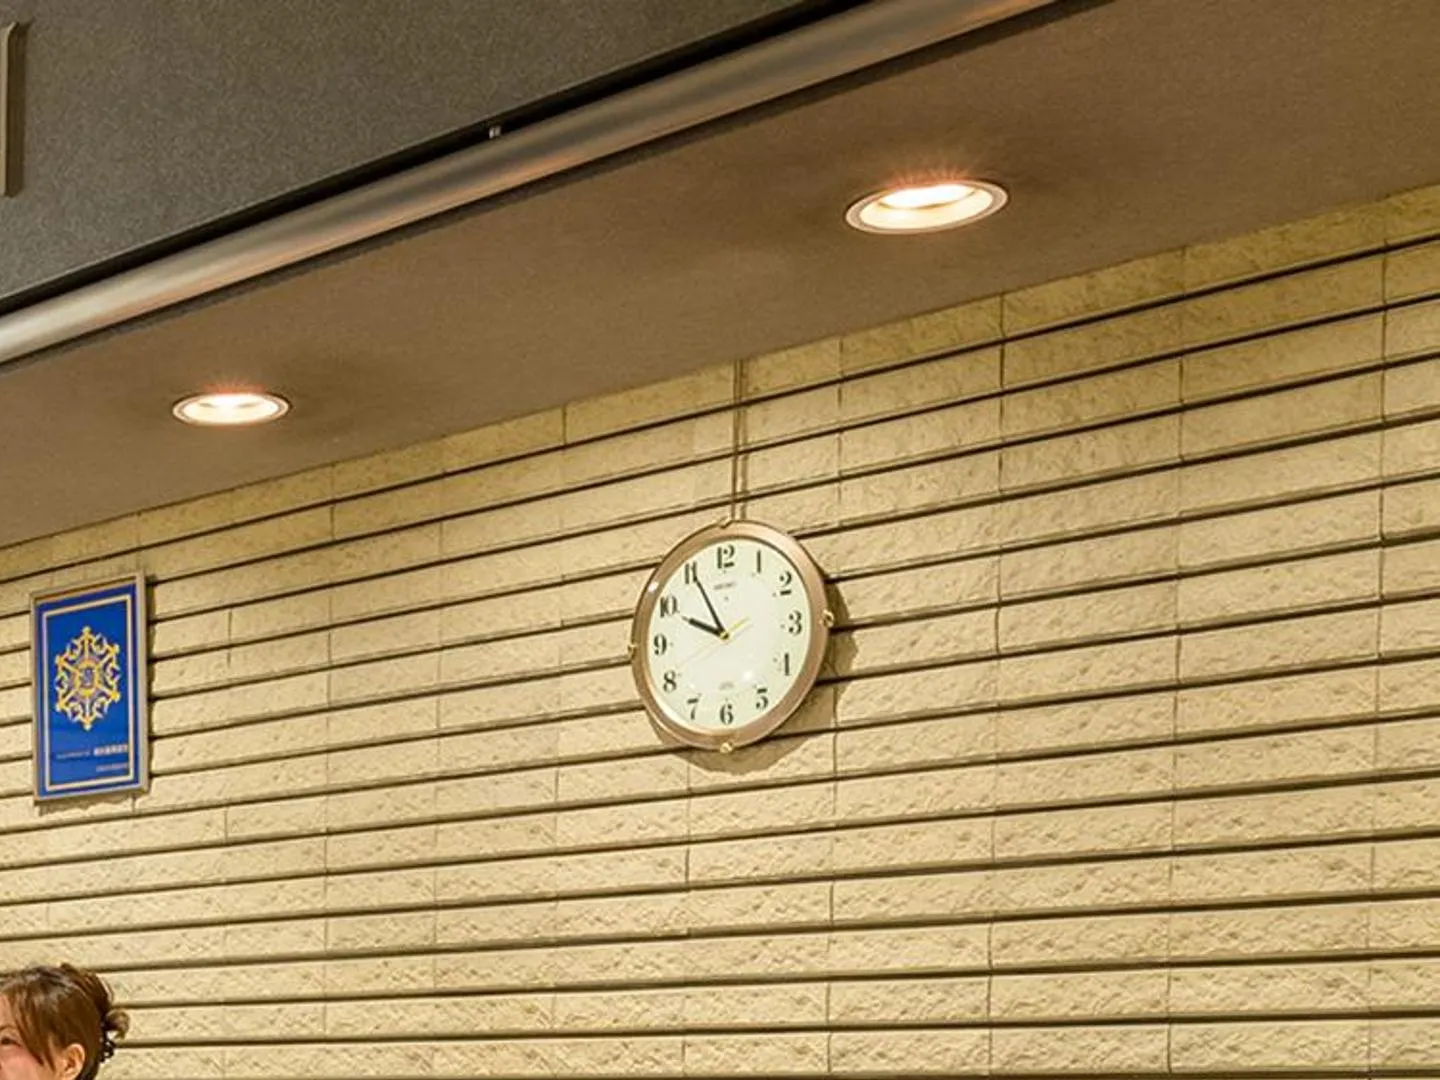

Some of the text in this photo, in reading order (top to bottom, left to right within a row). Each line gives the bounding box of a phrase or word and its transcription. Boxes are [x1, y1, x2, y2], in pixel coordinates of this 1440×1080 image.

[717, 544, 735, 569] 12
[756, 550, 761, 574] 1
[779, 571, 793, 596] 2
[659, 596, 678, 618] 10
[788, 610, 802, 636] 3
[653, 634, 667, 656] 9
[663, 670, 677, 692] 8
[687, 698, 698, 720] 7
[755, 687, 769, 709] 5
[720, 703, 734, 725] 6
